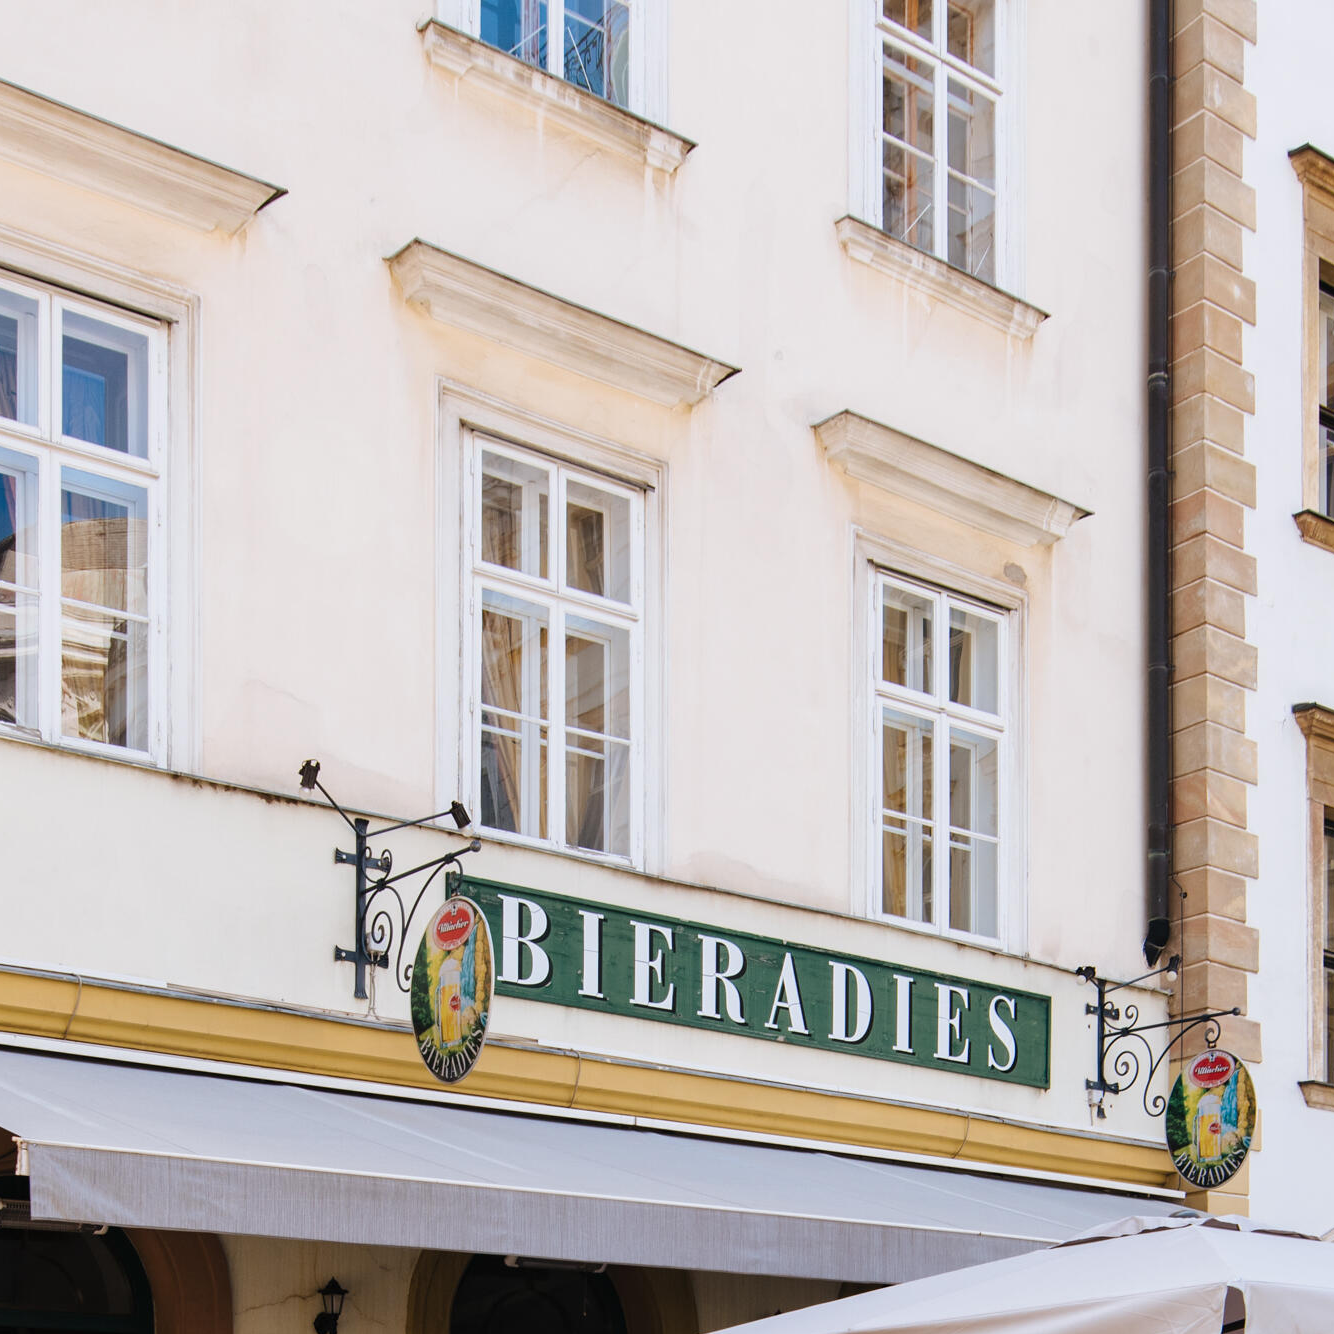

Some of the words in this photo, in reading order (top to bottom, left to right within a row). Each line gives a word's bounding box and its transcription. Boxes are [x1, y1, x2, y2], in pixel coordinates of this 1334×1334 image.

[496, 893, 1017, 1072] BIERADIES
[420, 1026, 484, 1079] BIERADIES
[1174, 1148, 1246, 1186] BIERADIES
